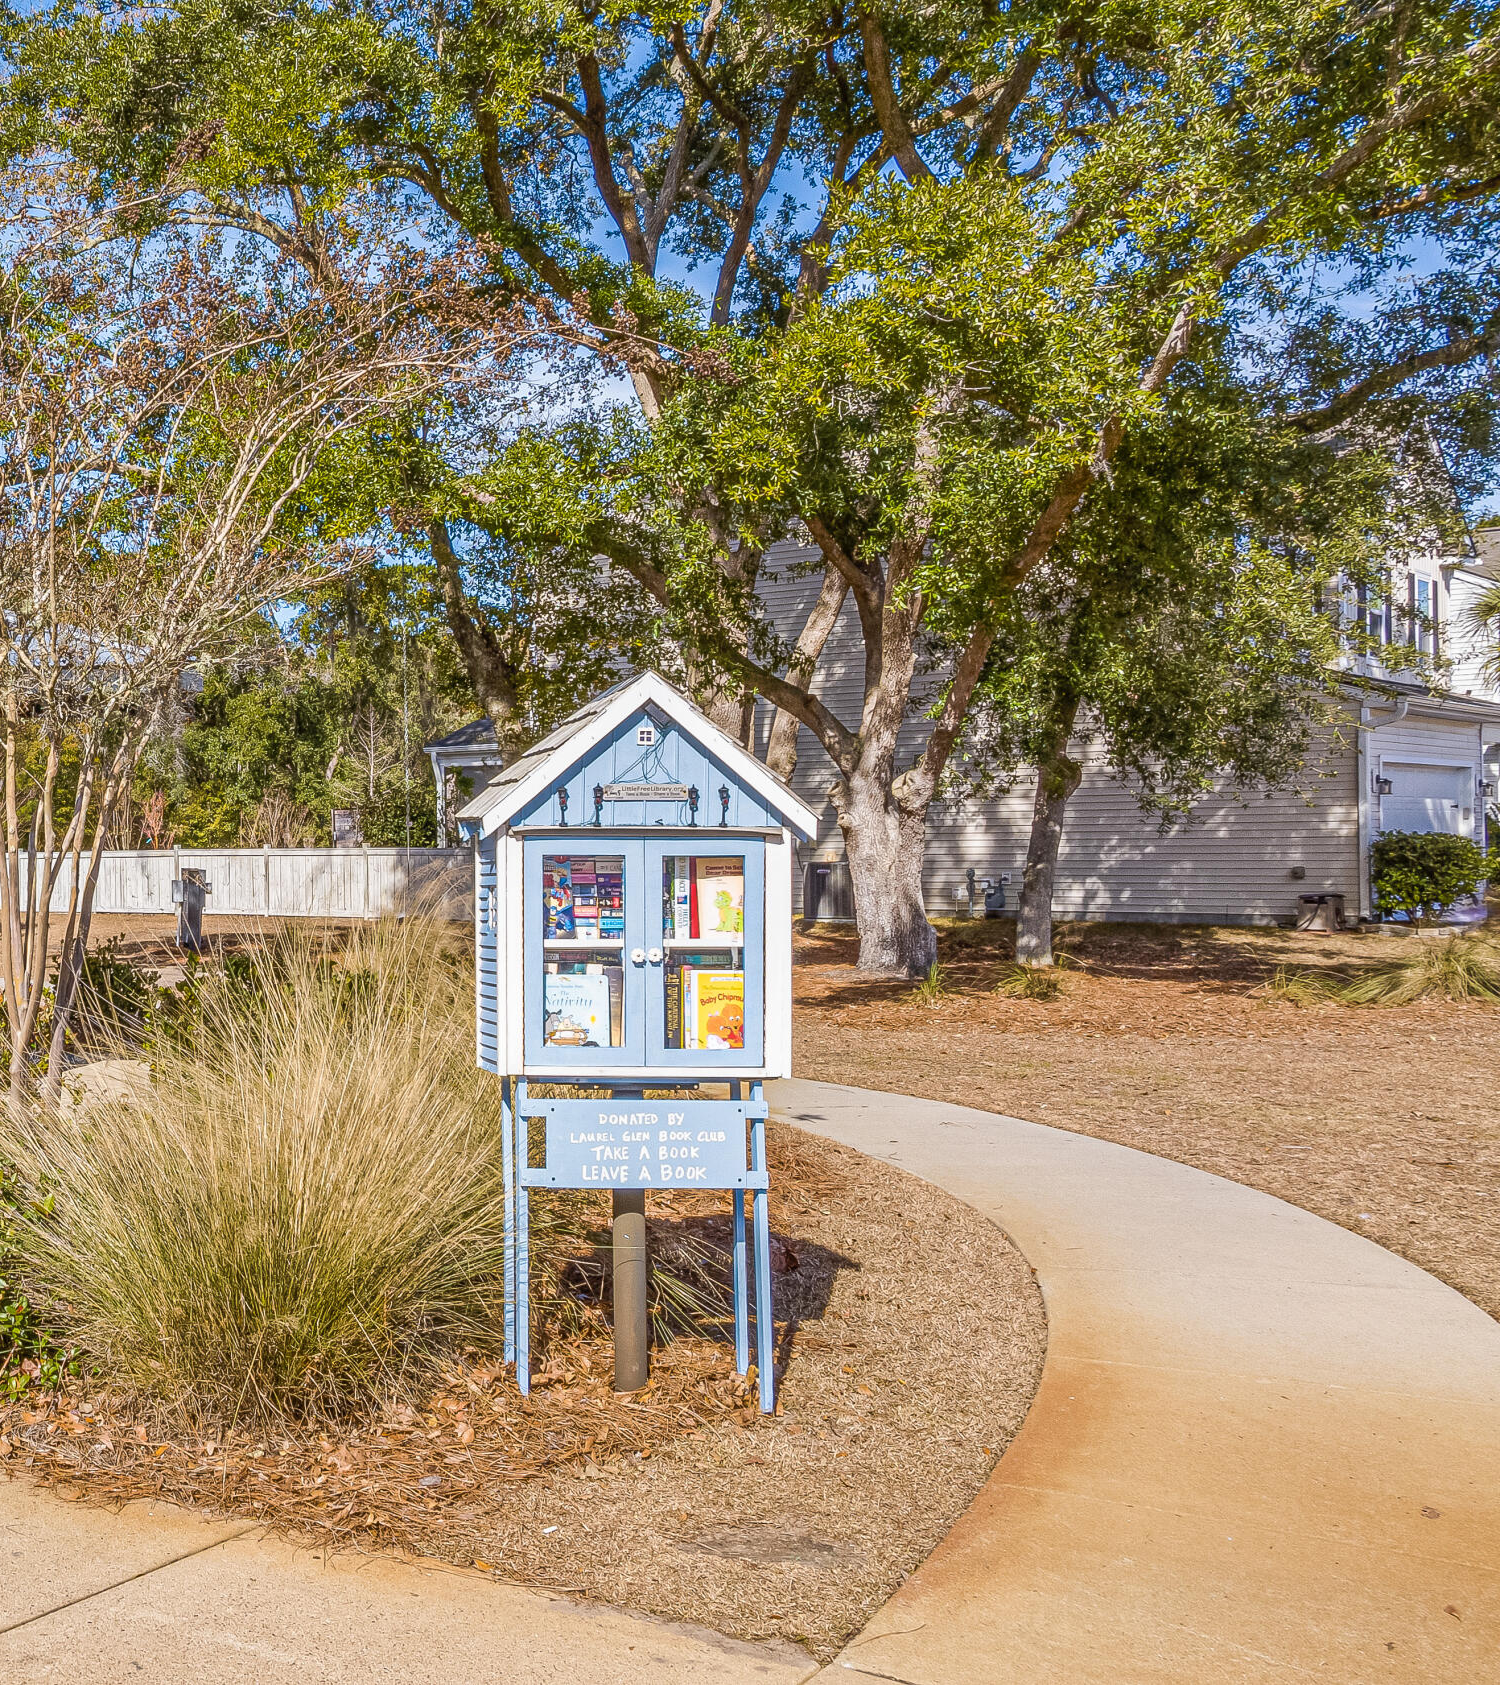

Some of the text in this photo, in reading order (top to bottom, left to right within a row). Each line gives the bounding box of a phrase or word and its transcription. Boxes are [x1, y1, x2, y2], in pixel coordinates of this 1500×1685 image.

[622, 785, 684, 793] LittleFreeLibrary.org
[700, 996, 716, 1006] Baby
[598, 1112, 684, 1126] DONATED BY
[570, 1130, 726, 1144] LAUREL GLEN BOOK CLUB
[590, 1144, 700, 1162] TAKE A BOOK
[582, 1164, 707, 1183] LEAVE A BOOK
